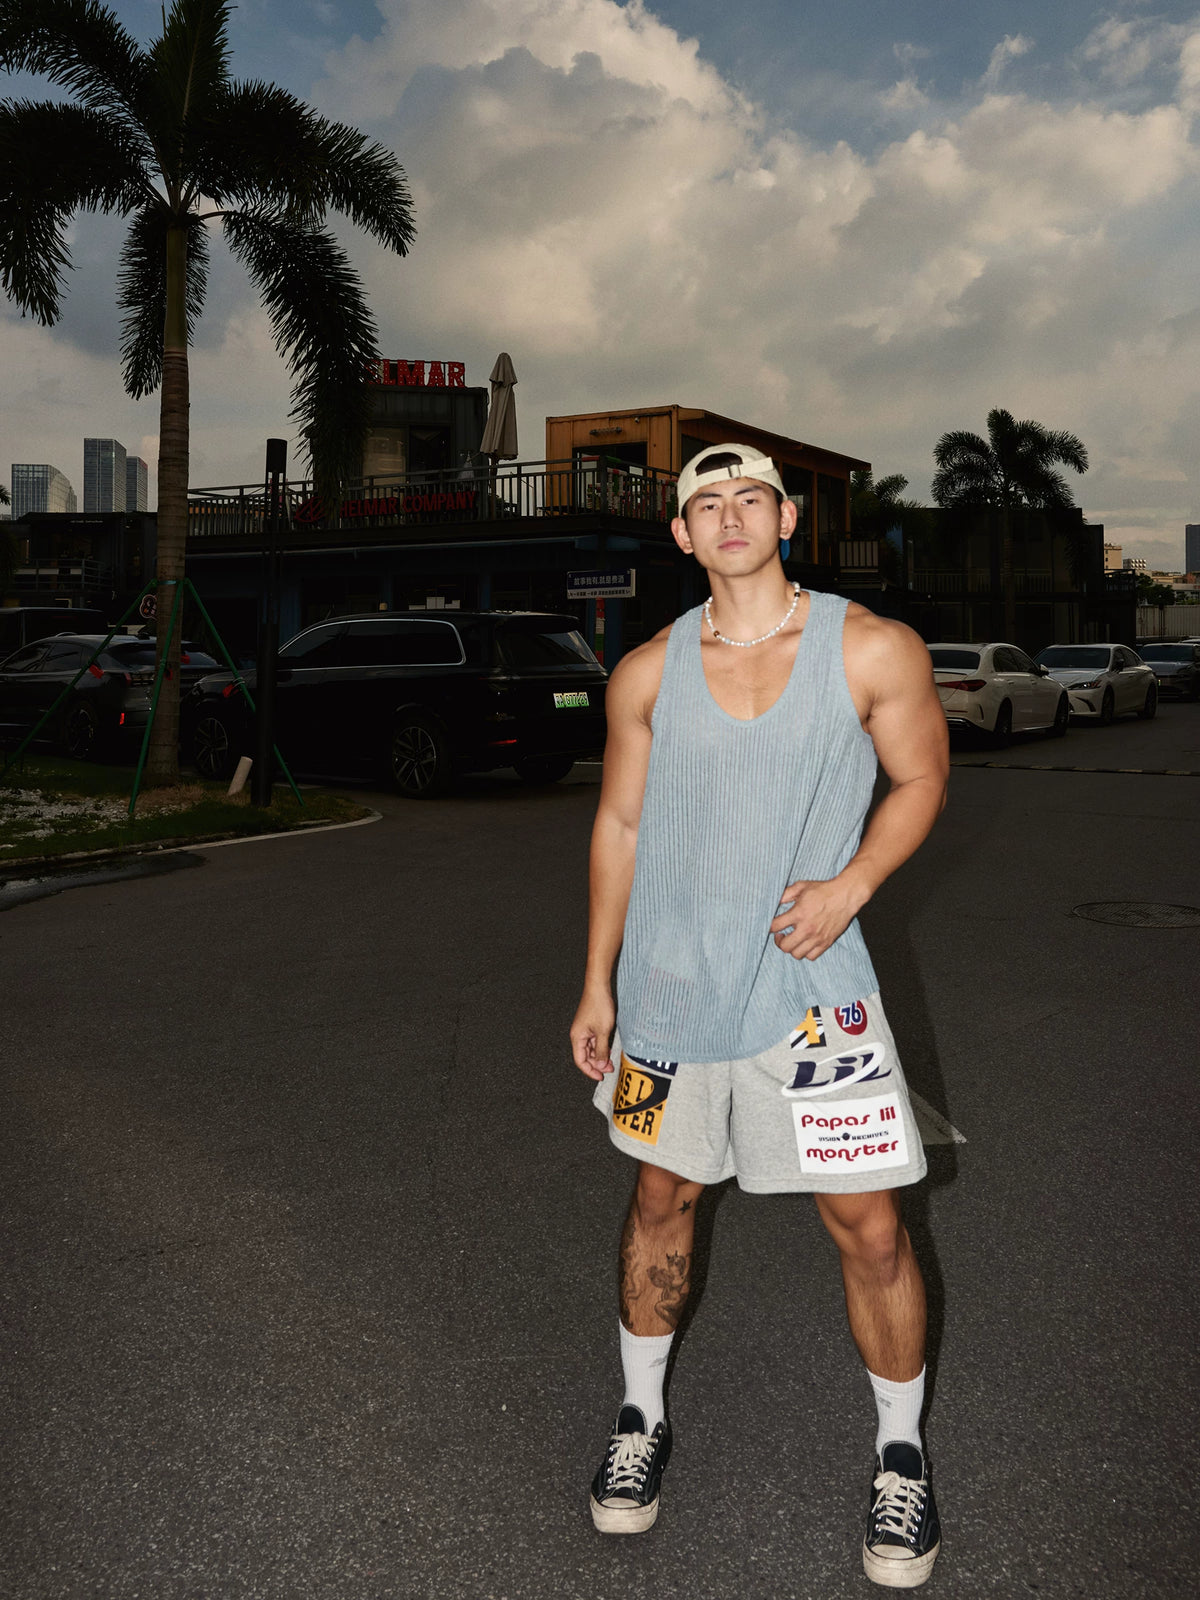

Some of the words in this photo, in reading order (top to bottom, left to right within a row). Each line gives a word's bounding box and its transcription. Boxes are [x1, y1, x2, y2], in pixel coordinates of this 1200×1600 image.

[339, 497, 399, 518] HELMAR
[402, 491, 477, 513] COMPANY
[840, 1001, 862, 1026] 76
[801, 1114, 870, 1131] Papas
[806, 1140, 899, 1162] monster
